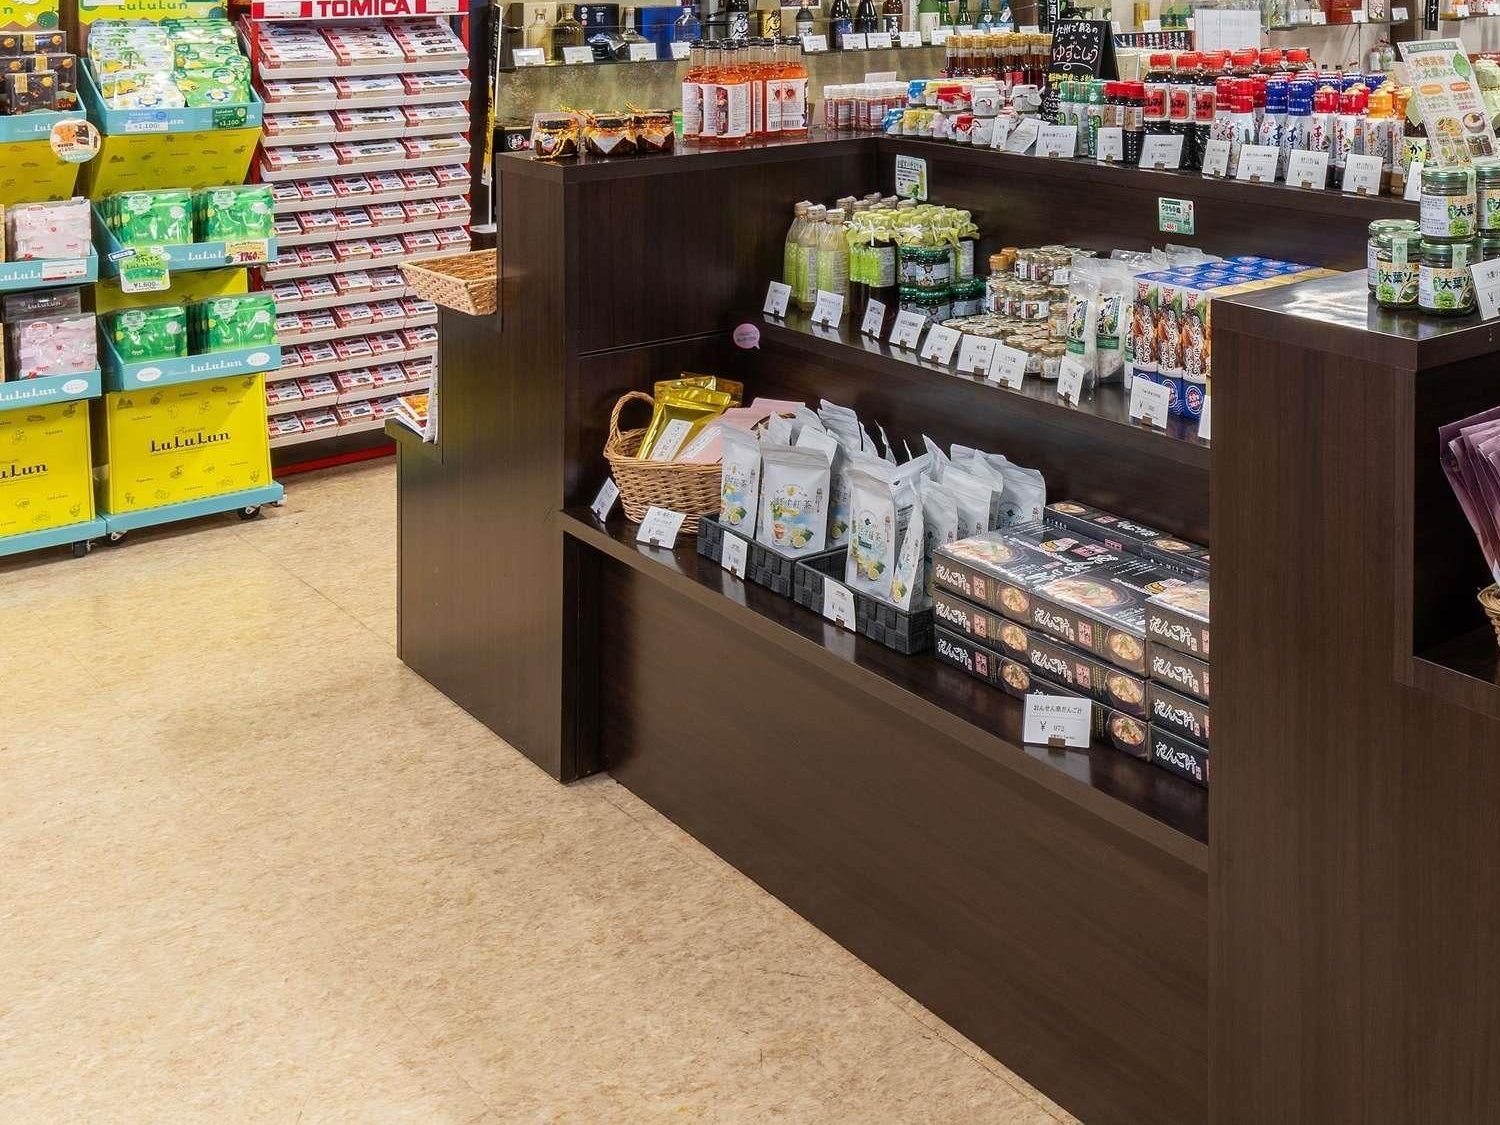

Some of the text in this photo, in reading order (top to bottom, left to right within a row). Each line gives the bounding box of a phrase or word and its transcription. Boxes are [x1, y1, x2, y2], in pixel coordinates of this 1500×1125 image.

[1053, 41, 1099, 64] ゆずこしょう
[149, 430, 232, 454] LuLuLun
[1033, 704, 1083, 714] おんせん県だんご汁
